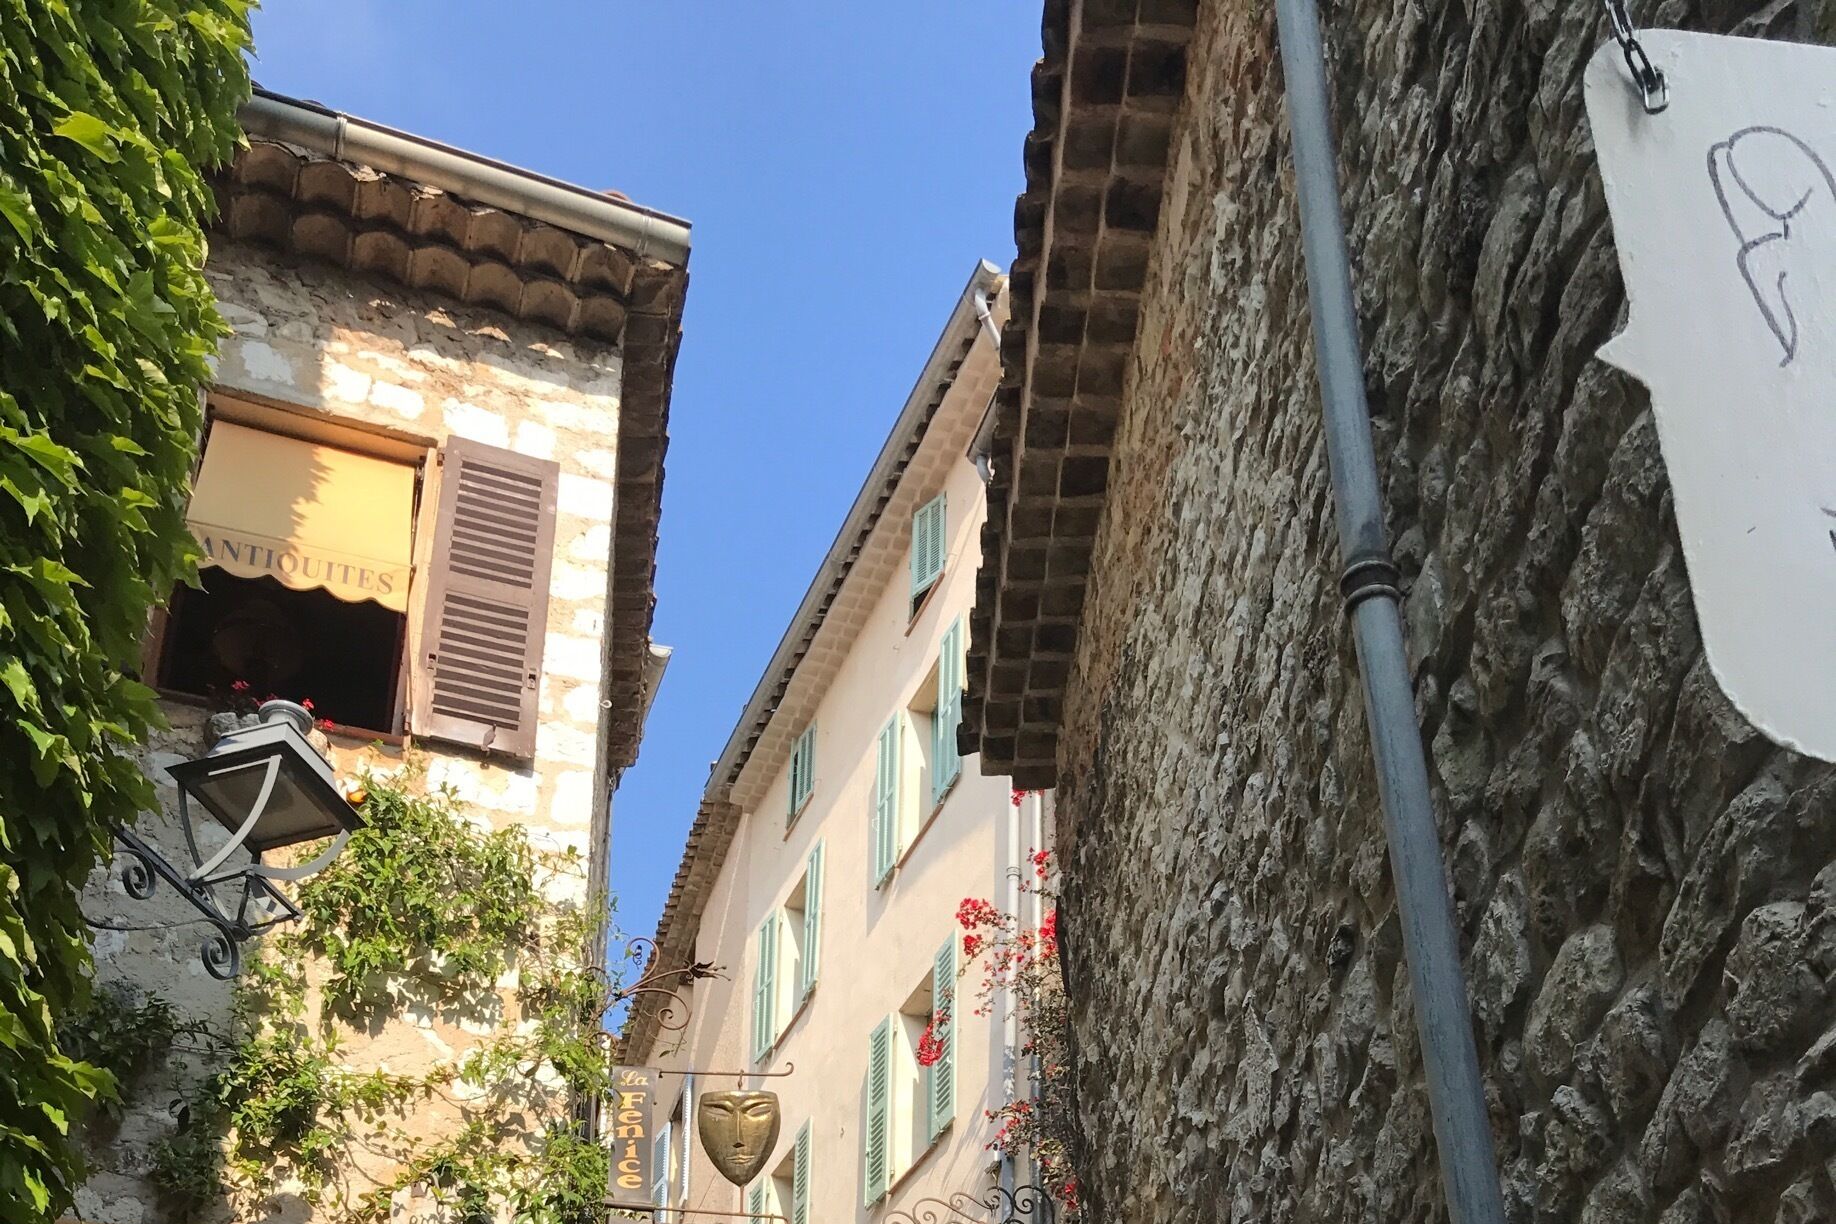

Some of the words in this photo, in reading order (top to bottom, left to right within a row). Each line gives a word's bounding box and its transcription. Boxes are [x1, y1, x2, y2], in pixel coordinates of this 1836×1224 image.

[201, 536, 394, 595] ANTIQUITES
[621, 1070, 649, 1086] La
[616, 1092, 646, 1189] Fenice
